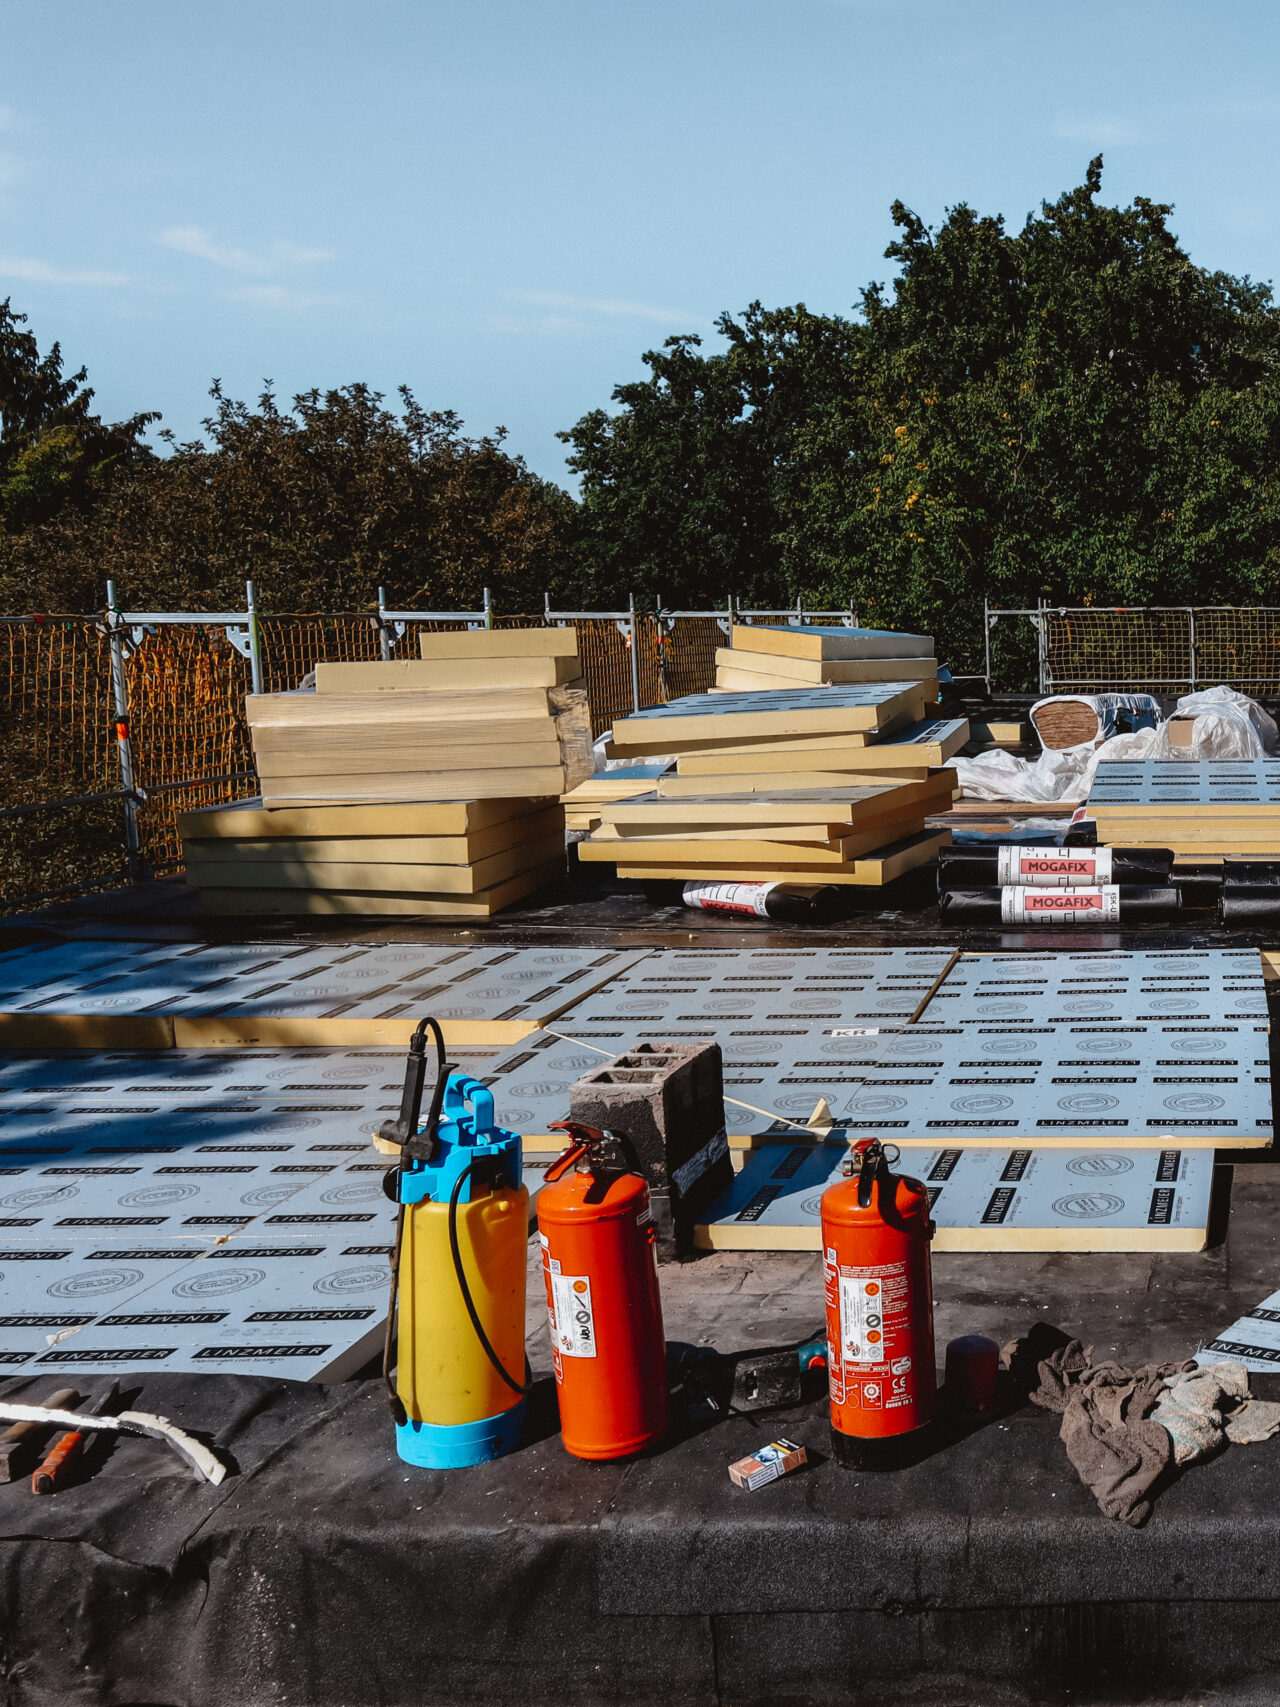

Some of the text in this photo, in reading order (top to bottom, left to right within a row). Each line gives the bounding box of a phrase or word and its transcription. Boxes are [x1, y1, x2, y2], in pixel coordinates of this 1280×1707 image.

[1028, 862, 1087, 872] MOGAFIX
[1033, 898, 1094, 908] MOGAFIX
[1158, 1151, 1177, 1181] LINZMEIER
[986, 1188, 1012, 1223] LINZMEIER
[1154, 1188, 1172, 1223] LINZMEIER
[103, 1315, 223, 1324] LINZMEIER
[43, 1351, 170, 1360] LINZMEIER
[199, 1347, 324, 1356] LINZMEIER
